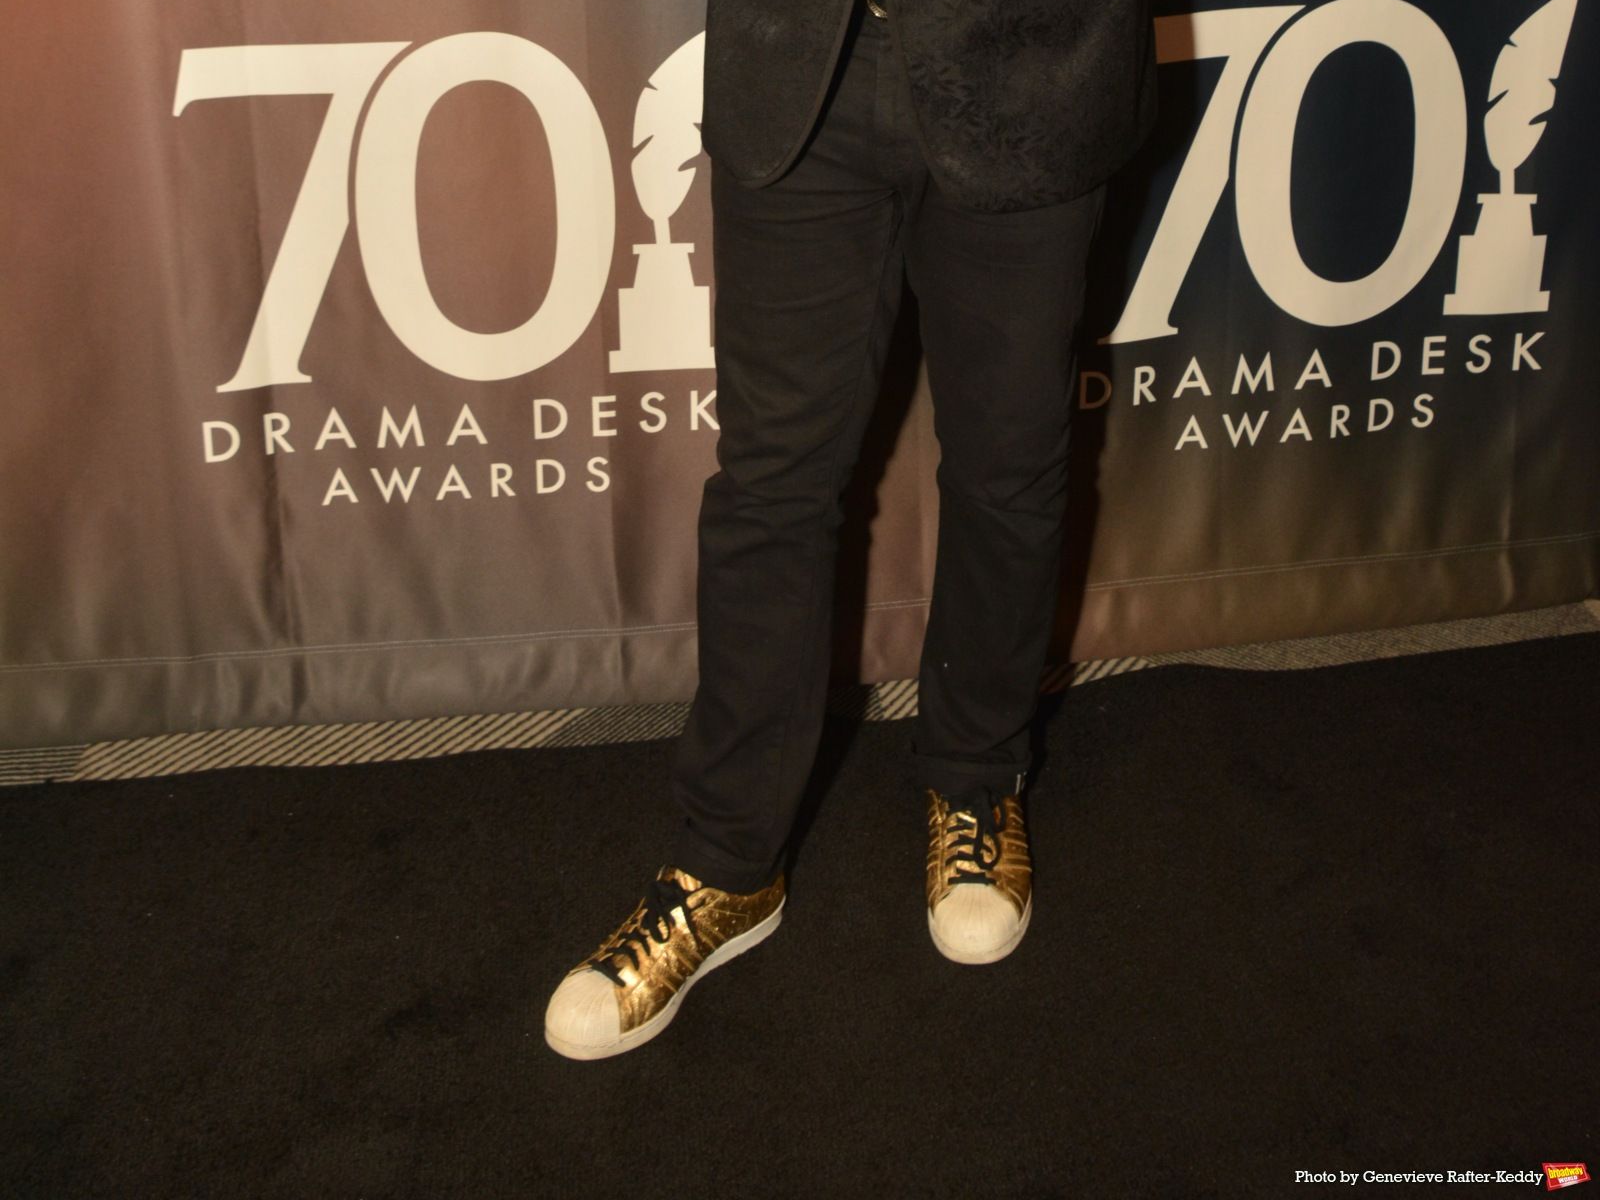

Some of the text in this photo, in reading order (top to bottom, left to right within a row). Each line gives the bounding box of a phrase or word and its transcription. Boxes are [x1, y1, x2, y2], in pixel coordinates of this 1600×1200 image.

[172, 31, 616, 393] 70
[1079, 331, 1545, 410] DRAMA DESK
[201, 389, 721, 464] DRAMA DESK
[1174, 393, 1434, 451] AWARDS
[321, 456, 611, 506] AWARDS
